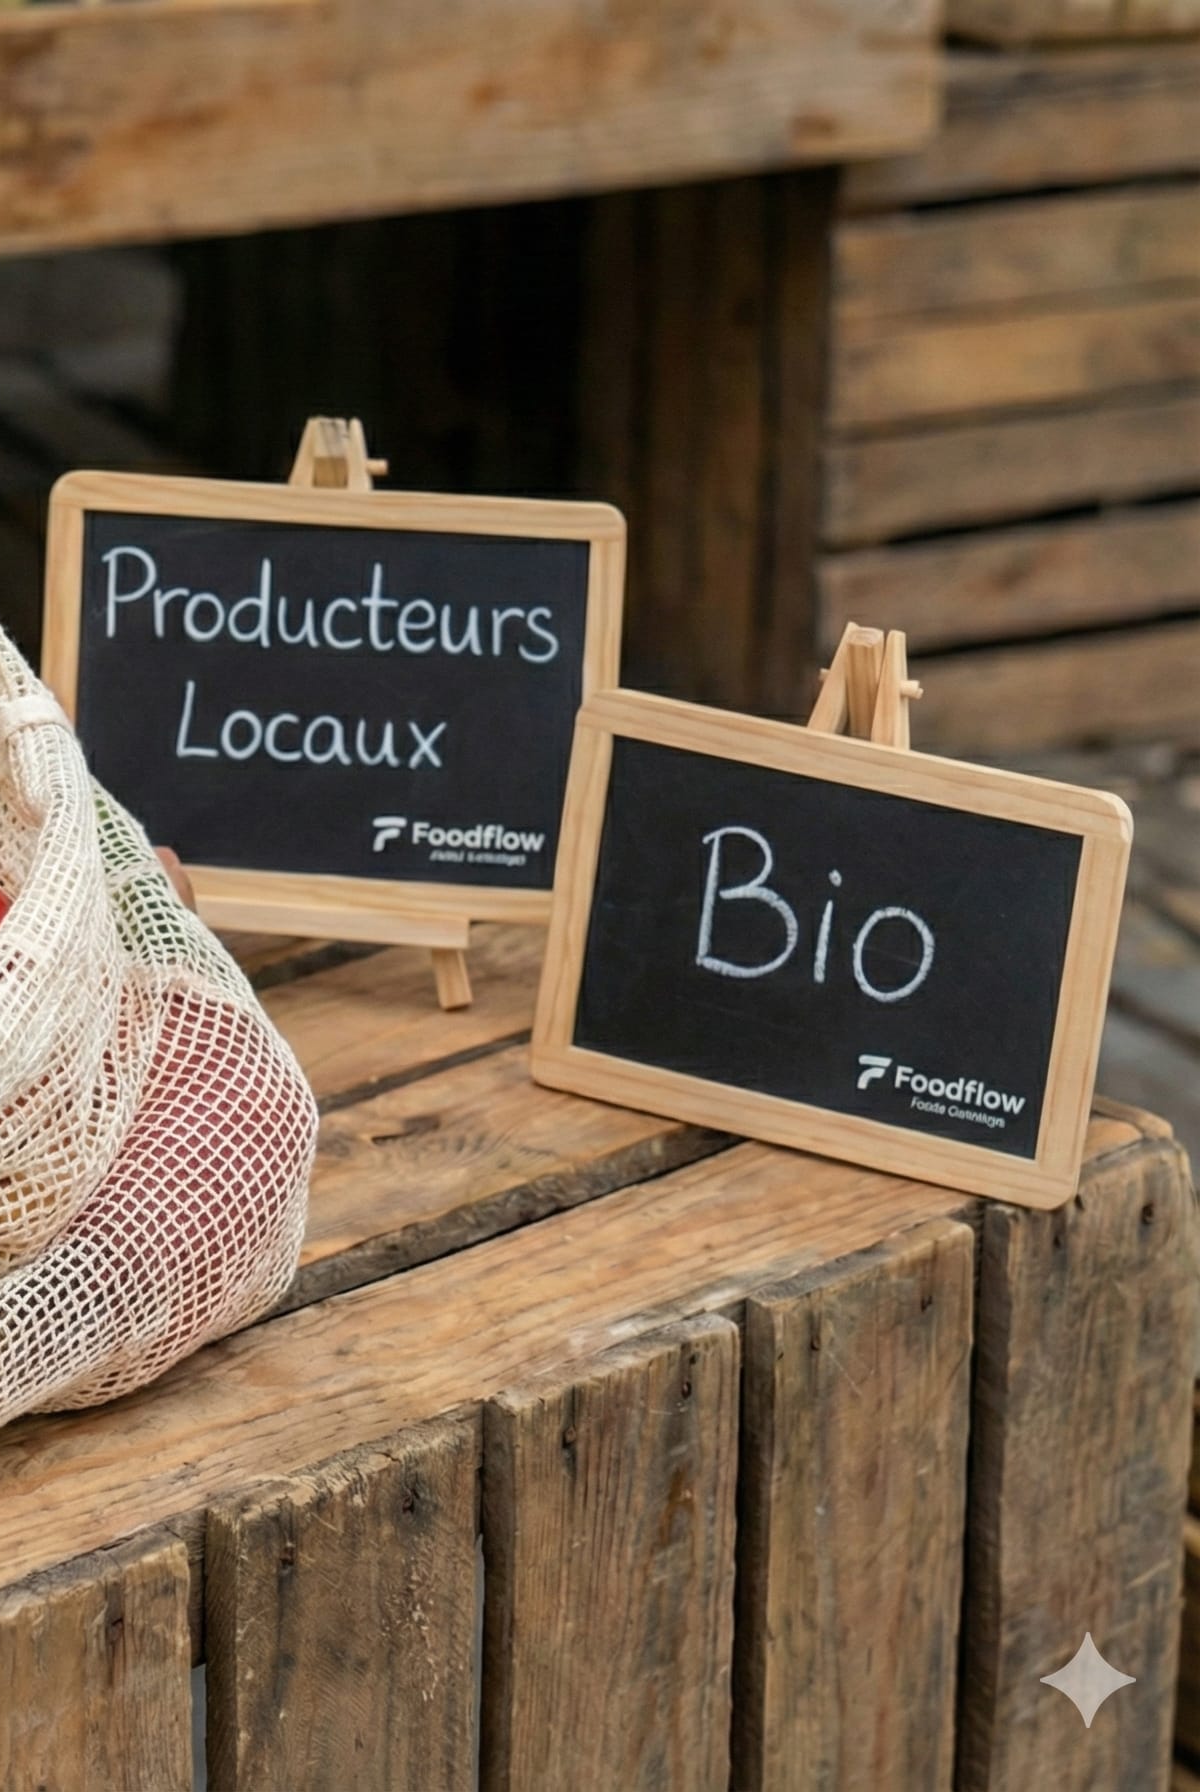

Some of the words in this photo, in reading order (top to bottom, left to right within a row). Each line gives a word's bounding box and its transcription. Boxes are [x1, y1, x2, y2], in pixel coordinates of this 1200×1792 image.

[102, 546, 559, 663] Producteurs
[176, 680, 446, 769] Locaux
[411, 821, 545, 853] Foodflow
[695, 826, 935, 1002] Bio
[894, 1065, 1026, 1115] Foodflow
